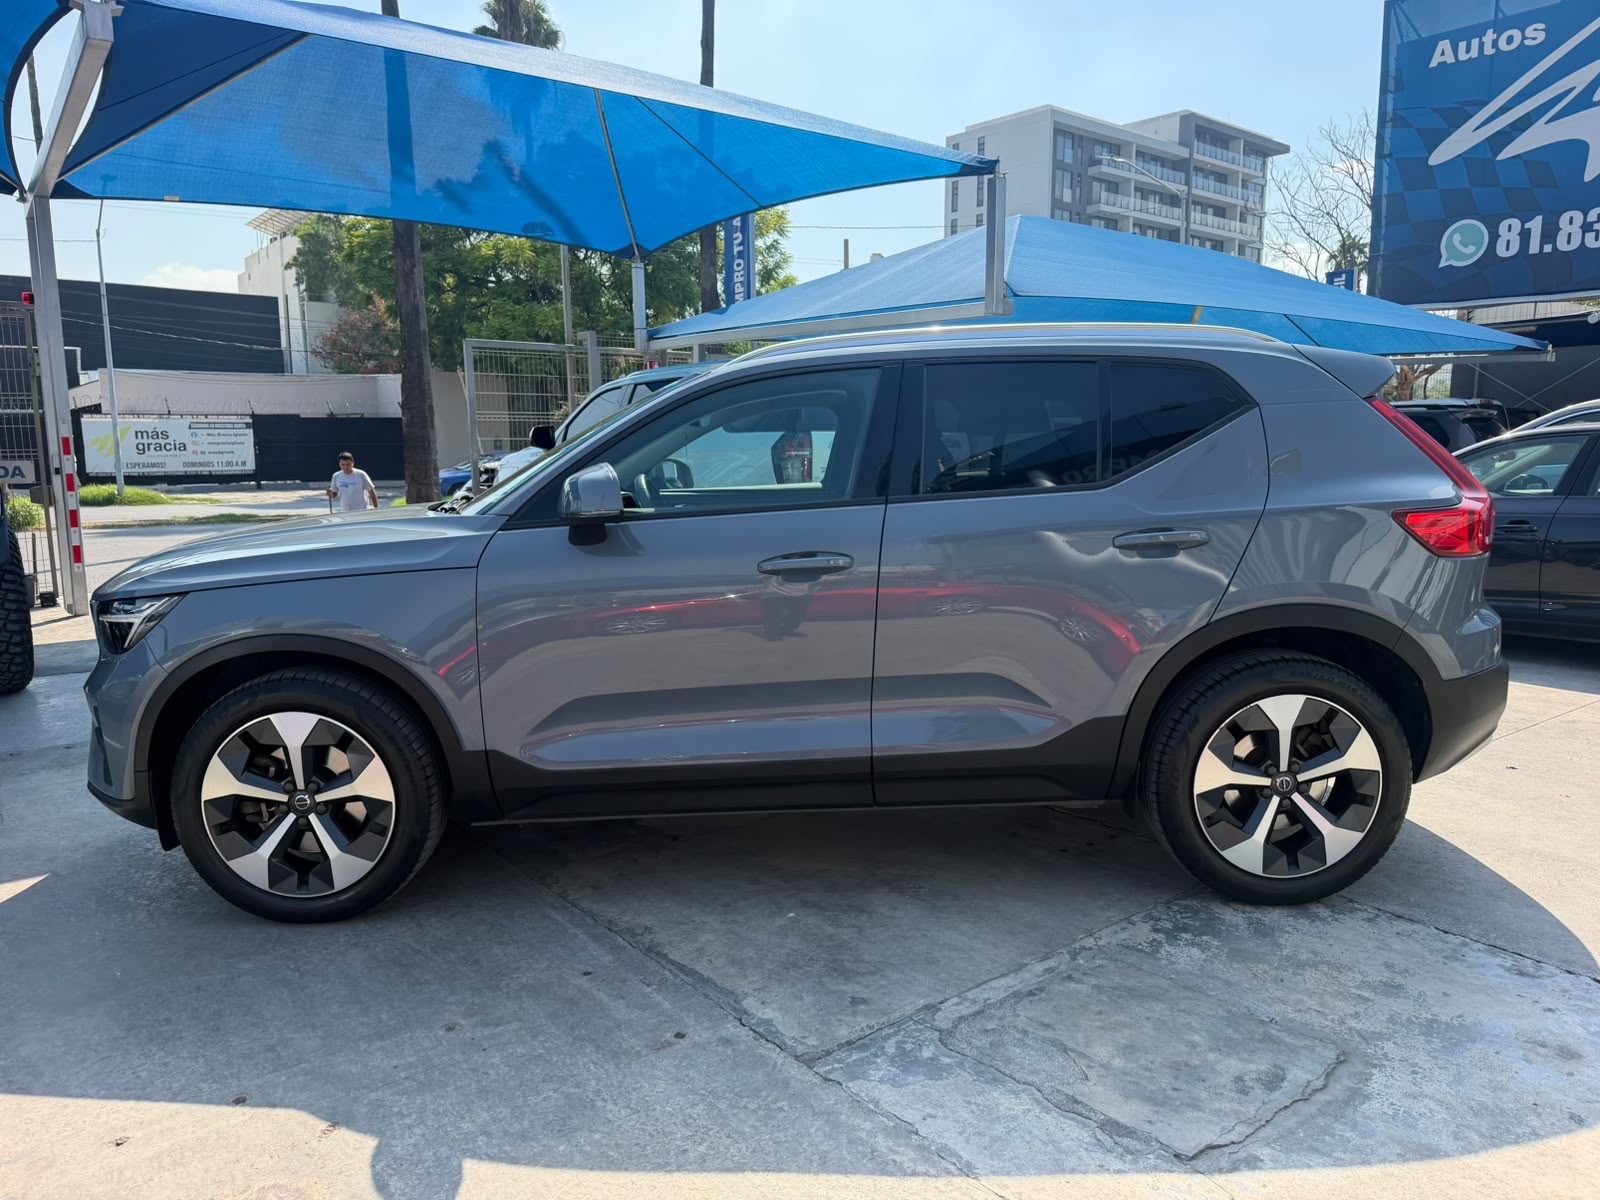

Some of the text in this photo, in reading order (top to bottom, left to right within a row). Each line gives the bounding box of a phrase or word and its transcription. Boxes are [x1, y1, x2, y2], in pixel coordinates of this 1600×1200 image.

[1429, 22, 1546, 69] Autos
[733, 232, 743, 255] TU
[135, 427, 169, 440] más
[136, 439, 187, 455] gracia
